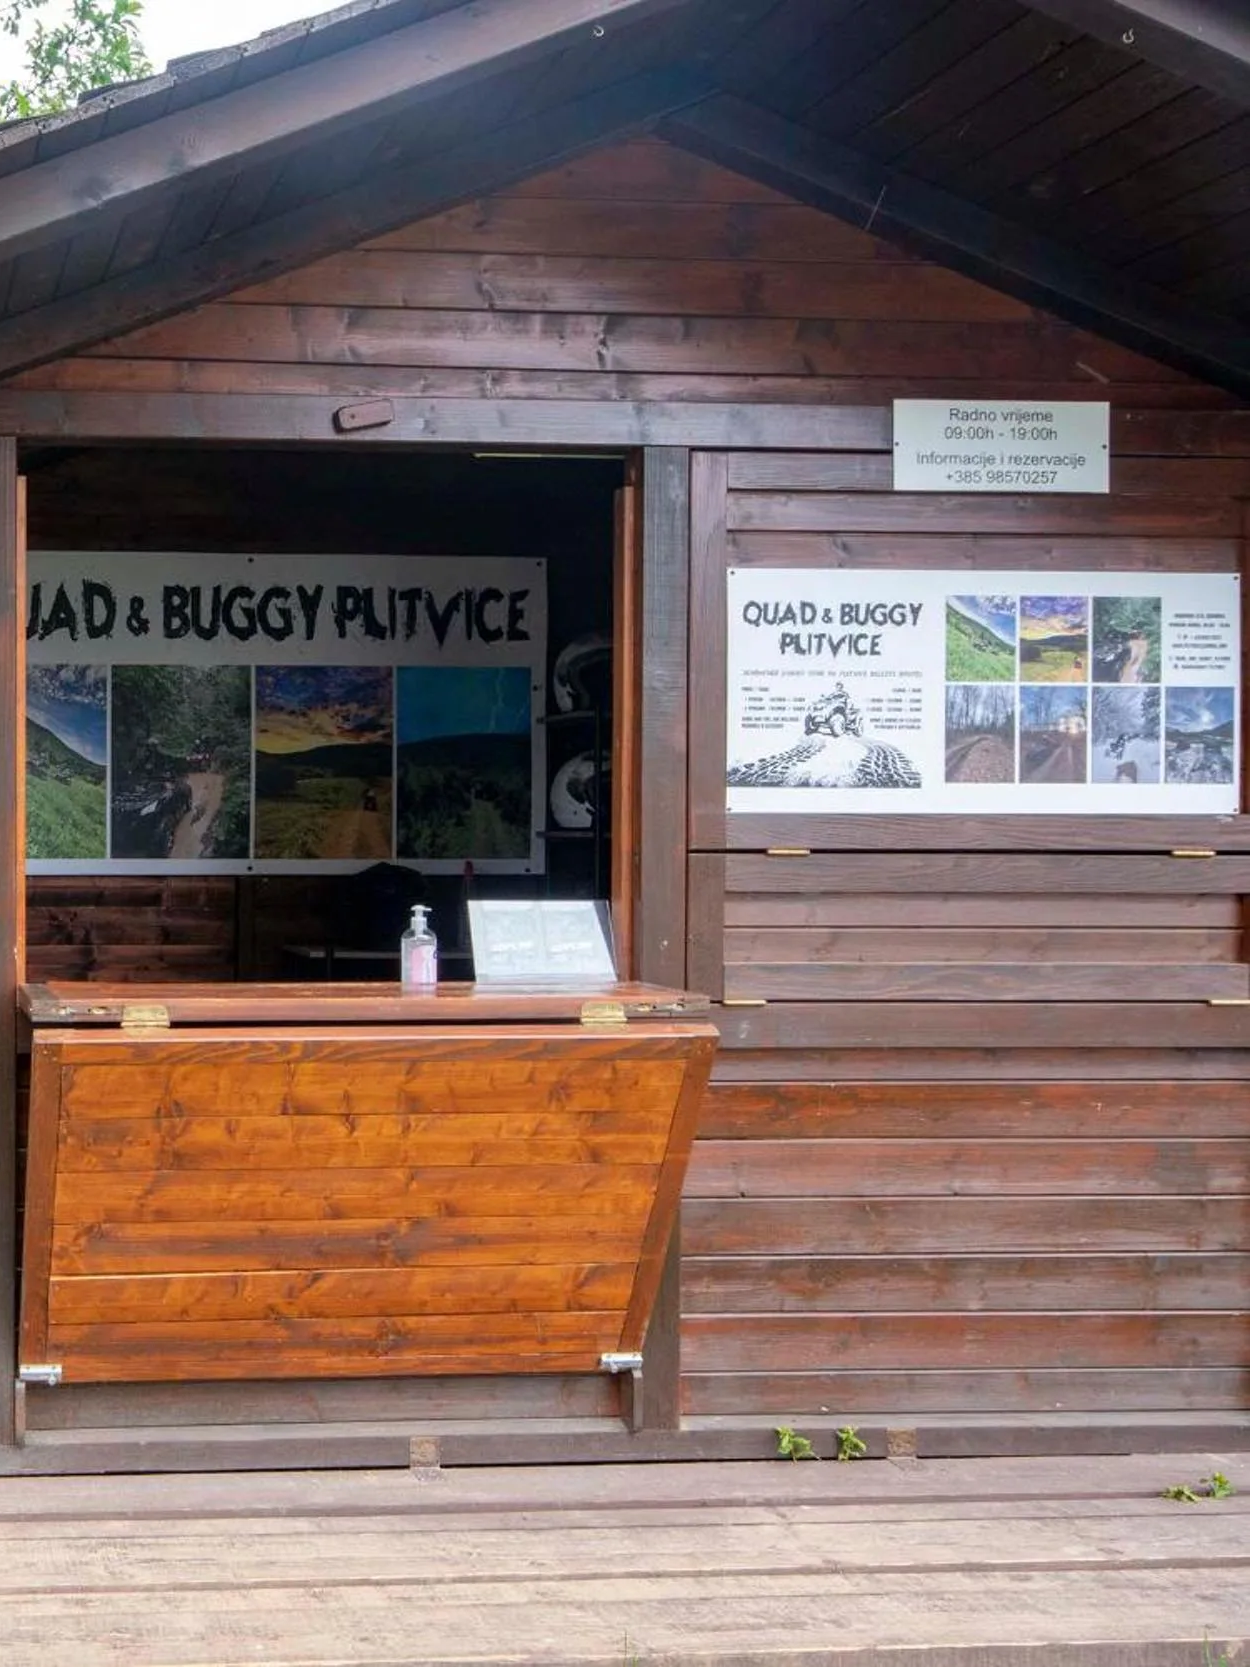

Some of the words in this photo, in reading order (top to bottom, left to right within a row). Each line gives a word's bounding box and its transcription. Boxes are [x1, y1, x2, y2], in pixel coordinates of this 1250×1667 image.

[949, 408, 997, 422] Radno
[1001, 408, 1053, 425] vrijeme
[944, 426, 994, 440] 09:00h
[1010, 427, 1058, 441] 19:00h
[916, 452, 996, 468] Informacije
[1007, 454, 1087, 469] rezervacije
[947, 470, 982, 484] +385
[986, 471, 1058, 485] 98570257
[127, 596, 150, 637] &
[163, 583, 324, 642] BUGGY
[332, 584, 531, 649] PLITVICE
[743, 600, 817, 627] QUAD
[822, 608, 833, 624] &
[840, 602, 923, 627] BUGGY
[780, 632, 882, 658] PLITVICE
